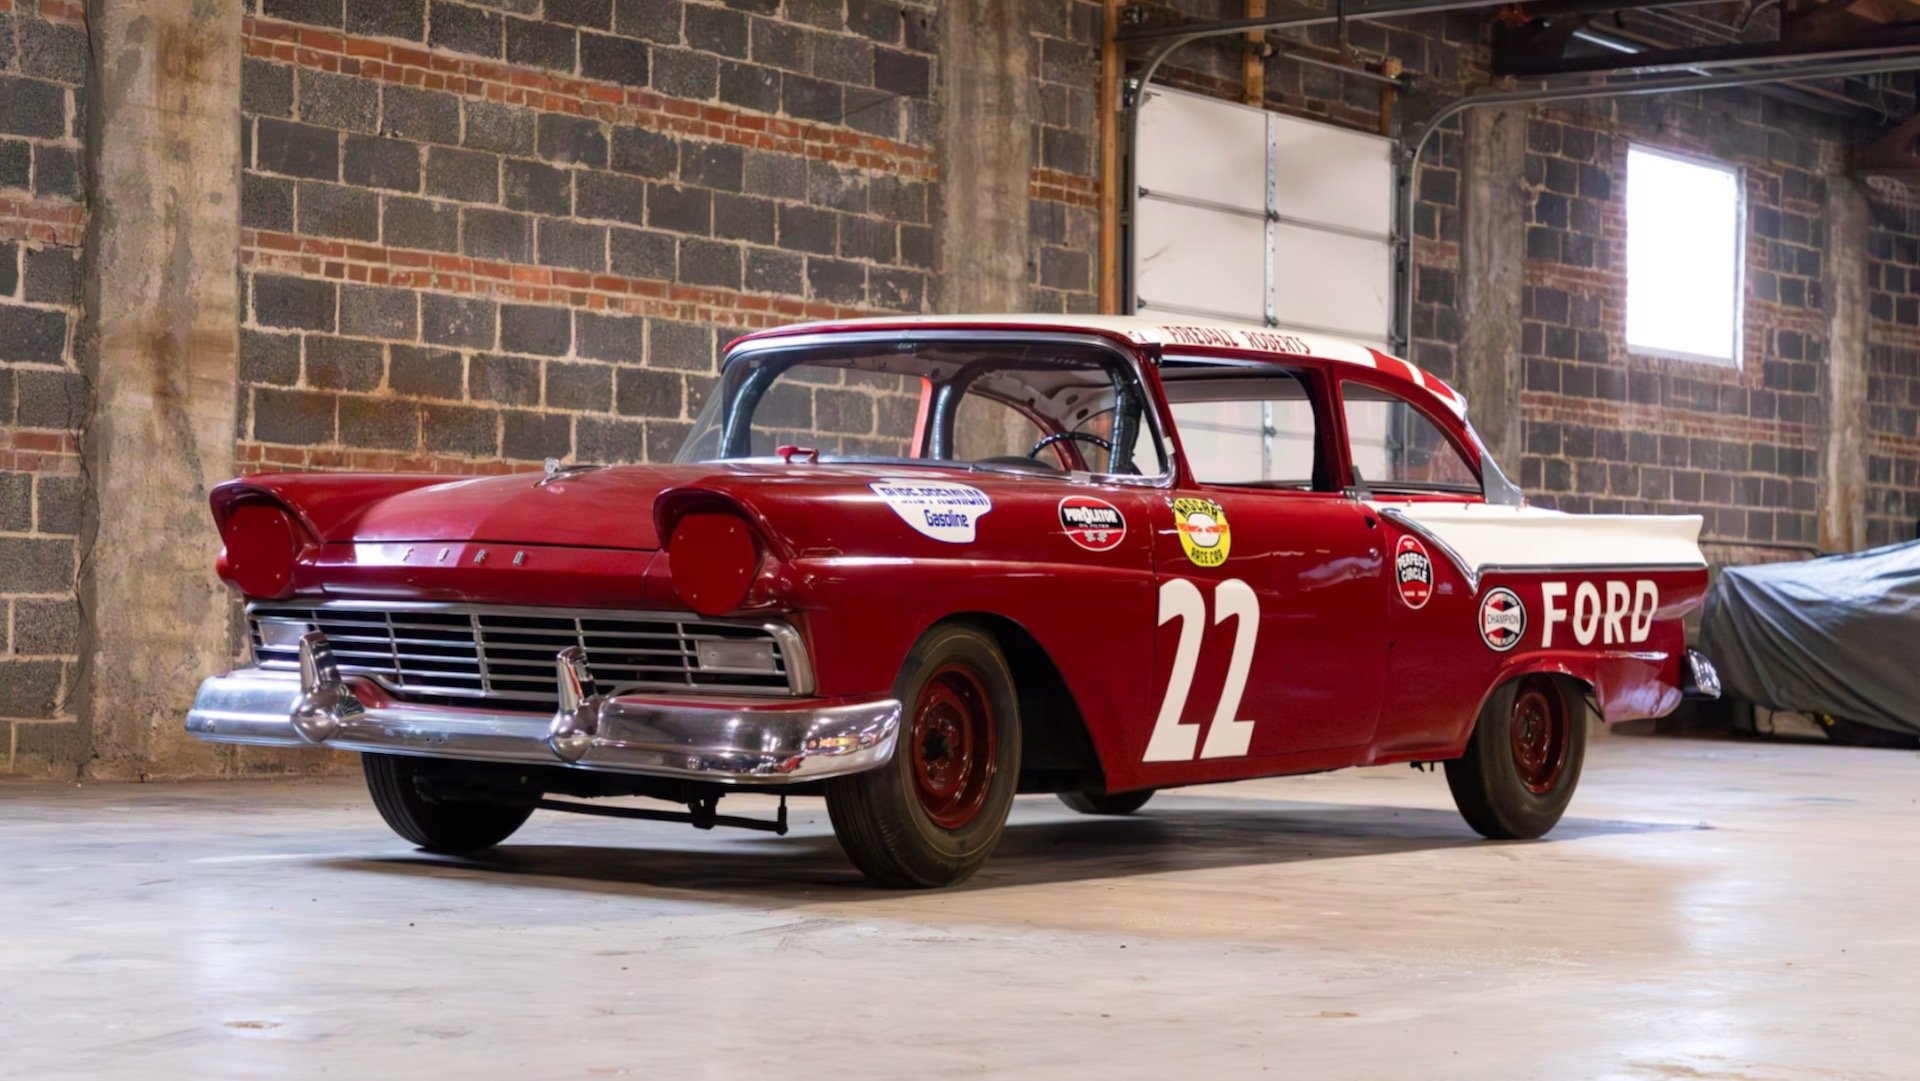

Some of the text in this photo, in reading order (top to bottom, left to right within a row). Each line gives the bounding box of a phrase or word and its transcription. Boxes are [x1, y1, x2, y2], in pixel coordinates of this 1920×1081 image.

[1240, 330, 1311, 355] ROBERTS
[923, 508, 969, 528] Gasoline
[1175, 499, 1218, 521] NASCAR
[402, 547, 526, 567] FORD
[1191, 547, 1224, 564] RACE CAR
[1398, 552, 1428, 571] PERFECT
[1401, 567, 1427, 583] CIRCLE
[1487, 613, 1519, 625] CHAMPION
[1541, 580, 1659, 648] FORD
[1142, 578, 1260, 762] 22
